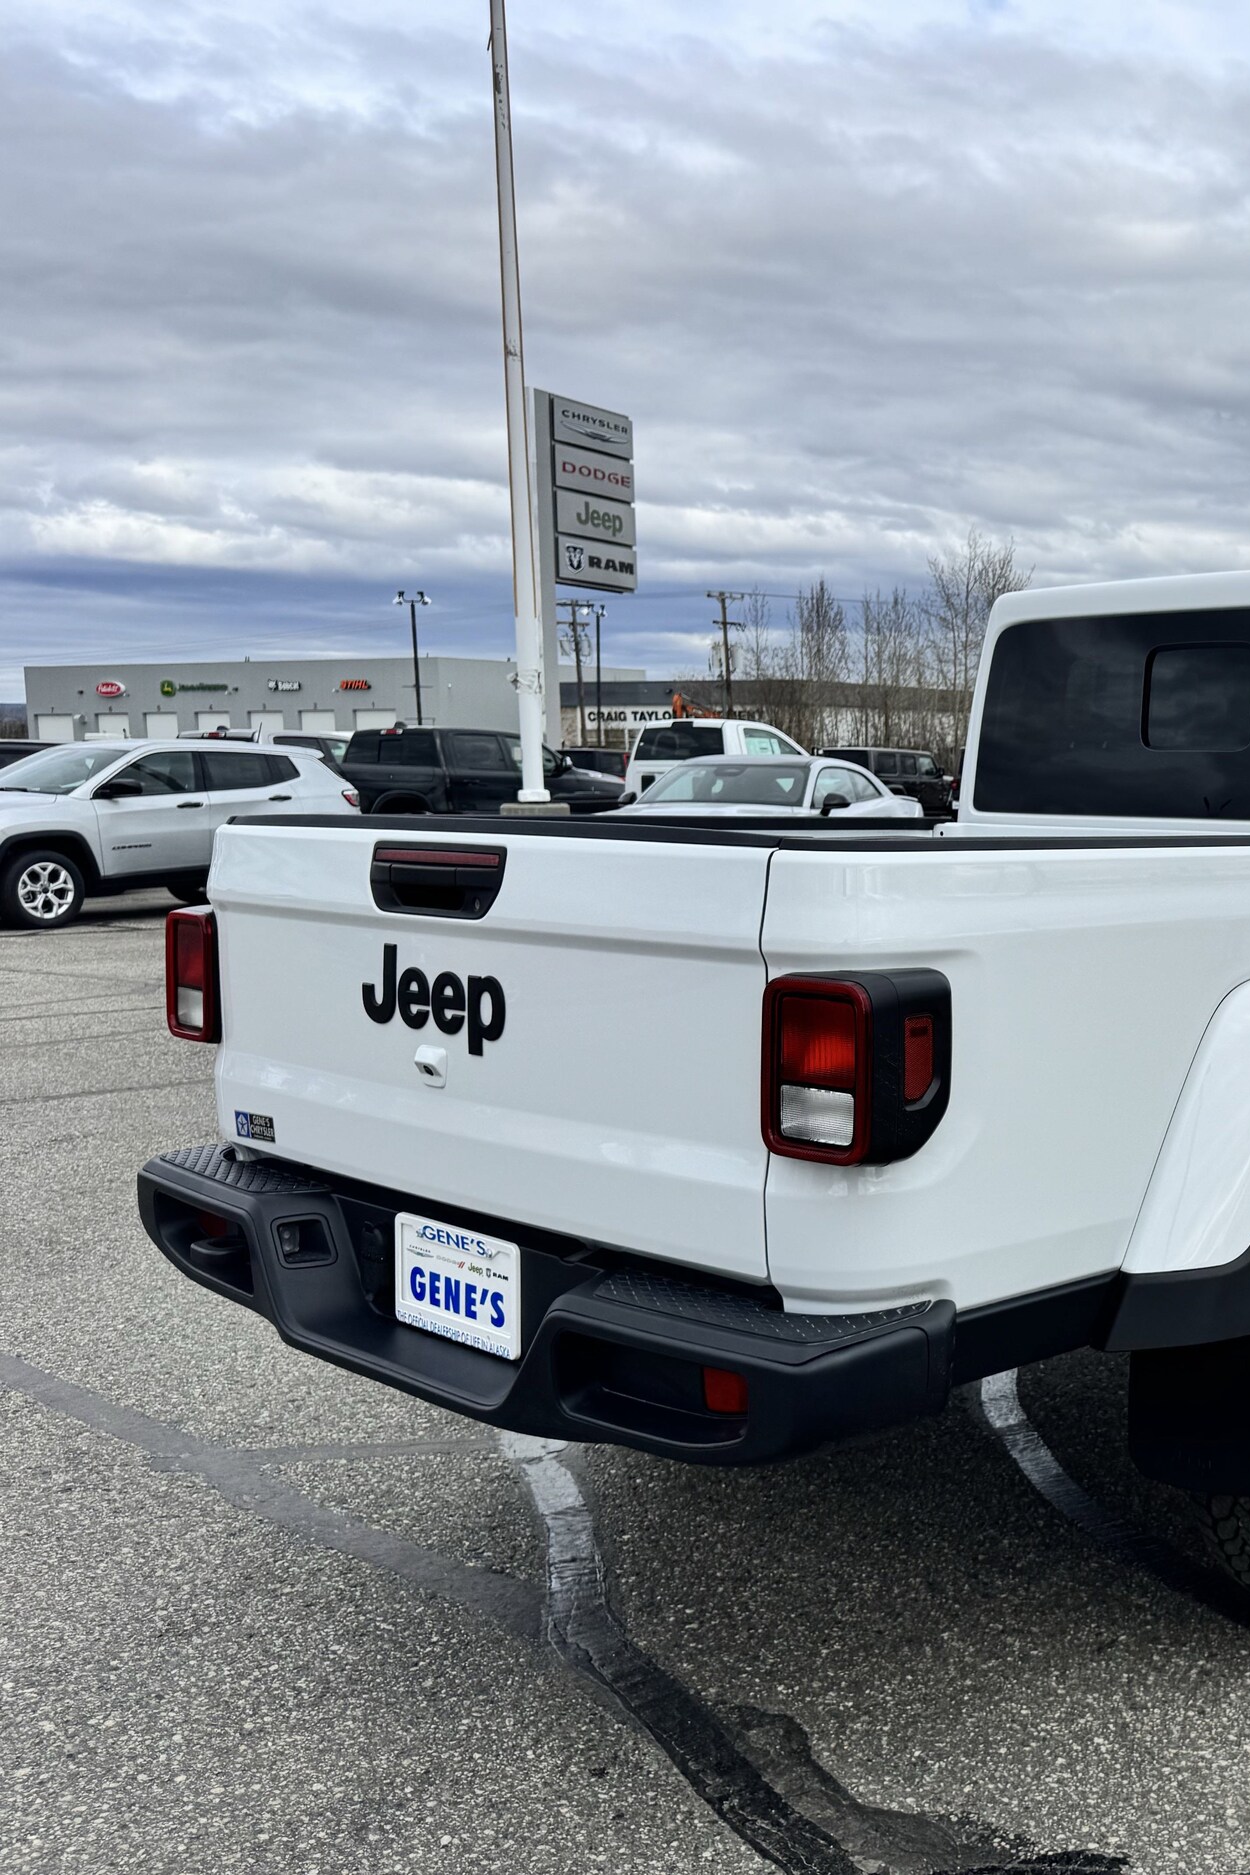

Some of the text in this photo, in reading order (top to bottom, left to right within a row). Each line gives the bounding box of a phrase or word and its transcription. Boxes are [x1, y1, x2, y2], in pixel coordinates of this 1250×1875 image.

[561, 409, 628, 435] CHRYSLER
[562, 461, 631, 488] DODGE
[576, 501, 624, 537] Jeep
[588, 555, 634, 575] RAM
[341, 680, 368, 690] STIHL
[588, 711, 627, 721] CRAIG
[631, 711, 677, 721] TAYLO
[362, 943, 506, 1057] Jeep
[423, 1225, 486, 1256] GENE'S
[468, 1262, 484, 1277] Jeep
[492, 1272, 509, 1281] RAM
[410, 1266, 505, 1328] GENE'S
